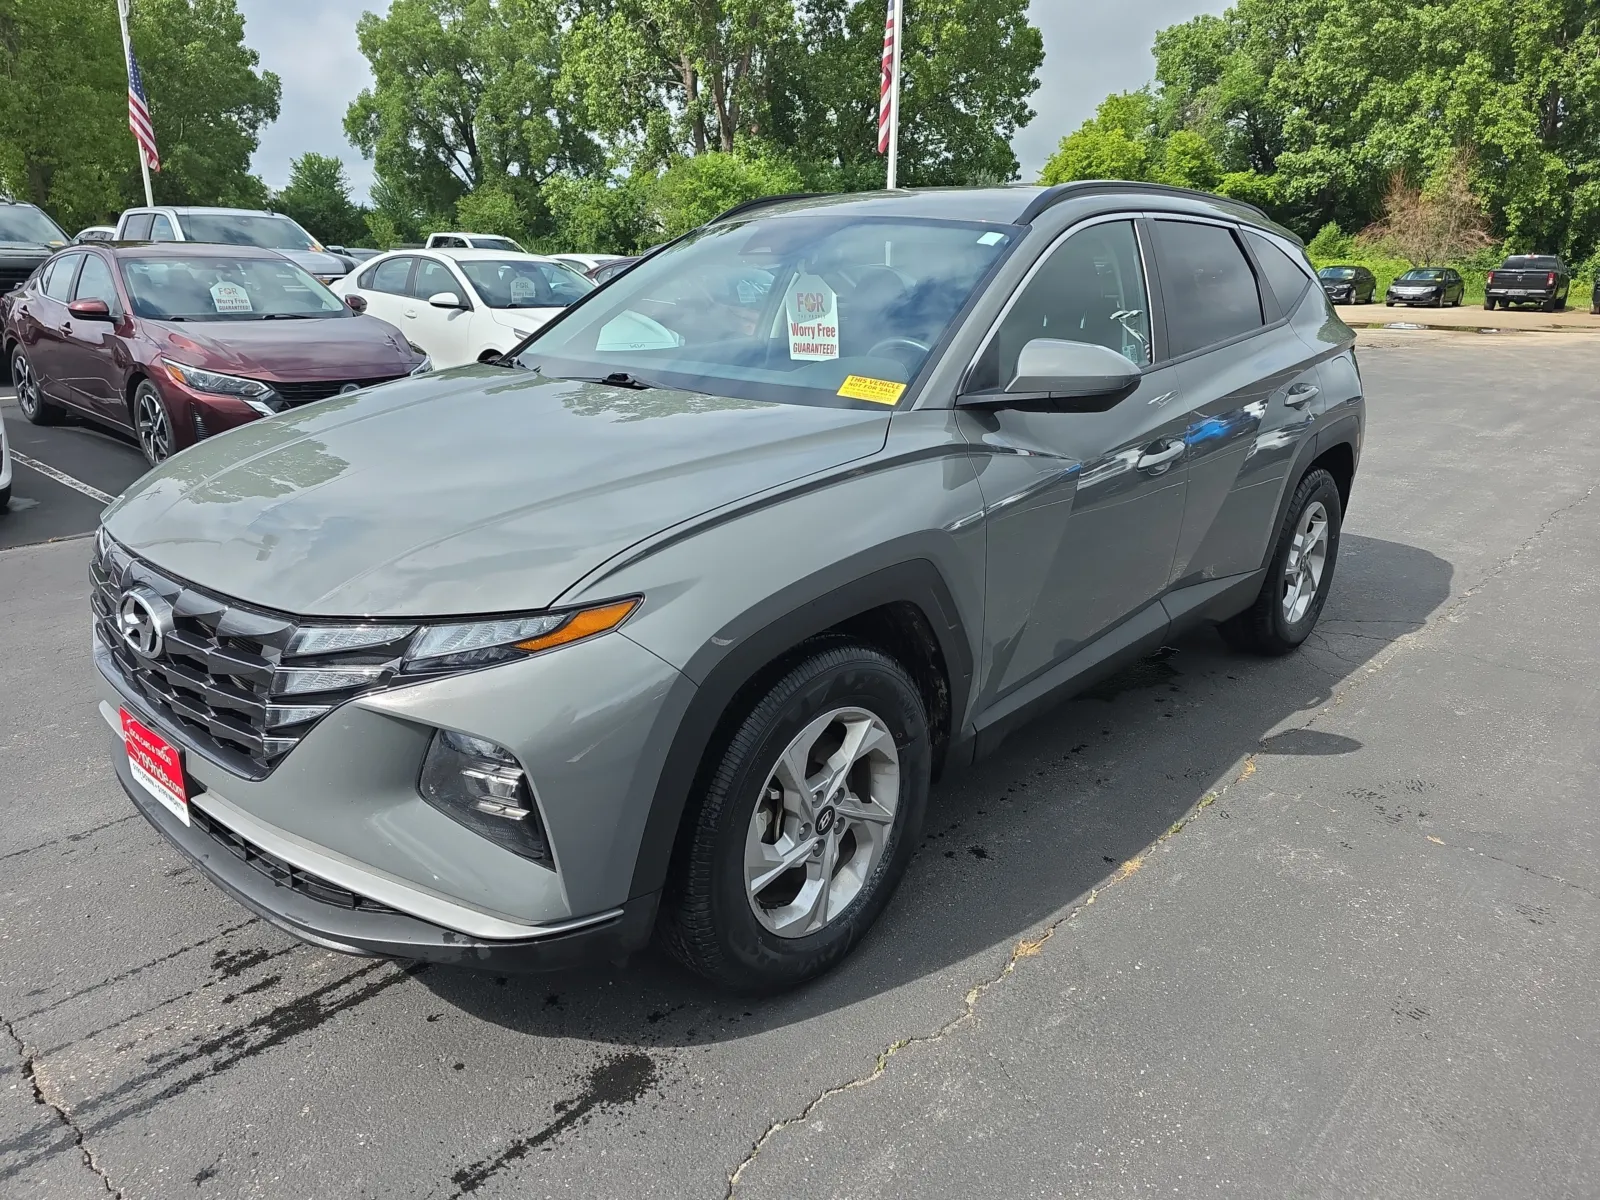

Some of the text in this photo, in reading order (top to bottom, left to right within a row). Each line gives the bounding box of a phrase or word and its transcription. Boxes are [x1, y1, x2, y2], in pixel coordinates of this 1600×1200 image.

[217, 287, 238, 295] FOR
[796, 292, 826, 313] FOR
[791, 322, 836, 339] Worry Free
[793, 342, 837, 355] GUARANTEED!
[850, 376, 901, 390] THIS VEHICLE
